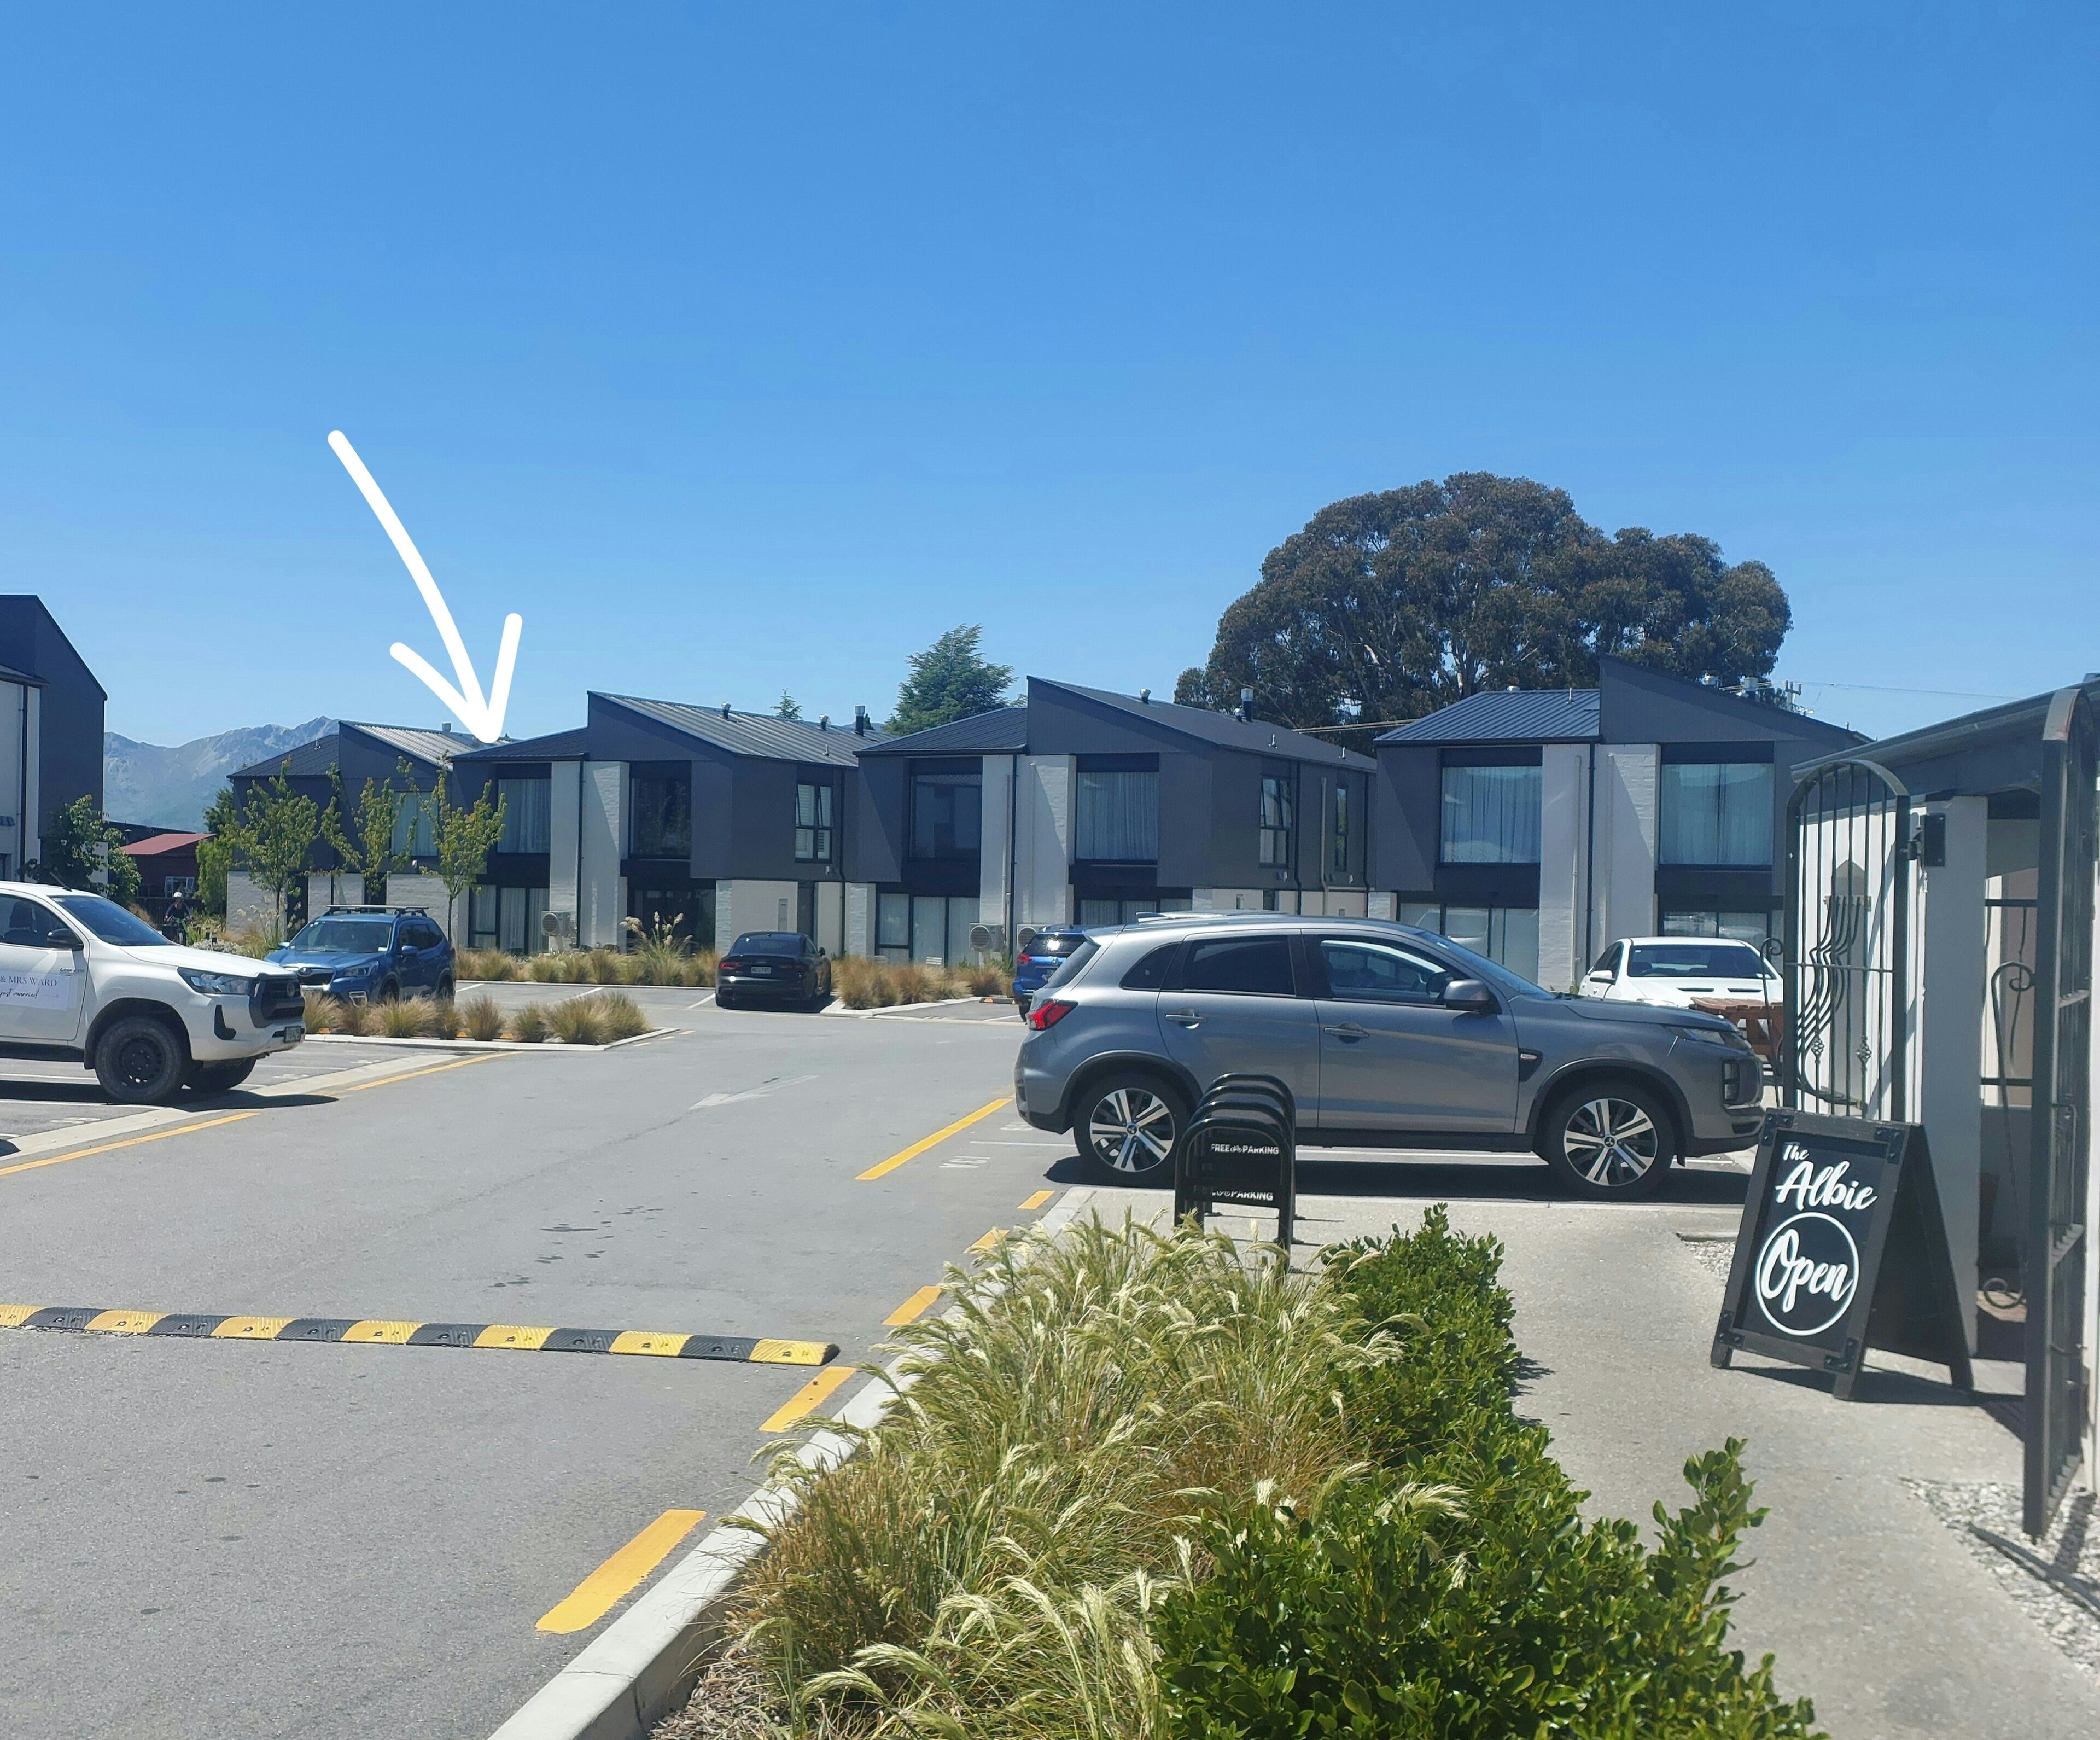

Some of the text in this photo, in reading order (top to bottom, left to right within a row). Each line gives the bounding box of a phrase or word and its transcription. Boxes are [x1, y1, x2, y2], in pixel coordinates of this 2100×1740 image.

[9, 976, 27, 984] MRS
[30, 977, 57, 986] WARD
[0, 988, 39, 999] just married
[1211, 1143, 1279, 1155] FREE PARKING
[1783, 1142, 1809, 1160] The
[1775, 1161, 1878, 1211] Albie
[1761, 1229, 1854, 1313] Open
